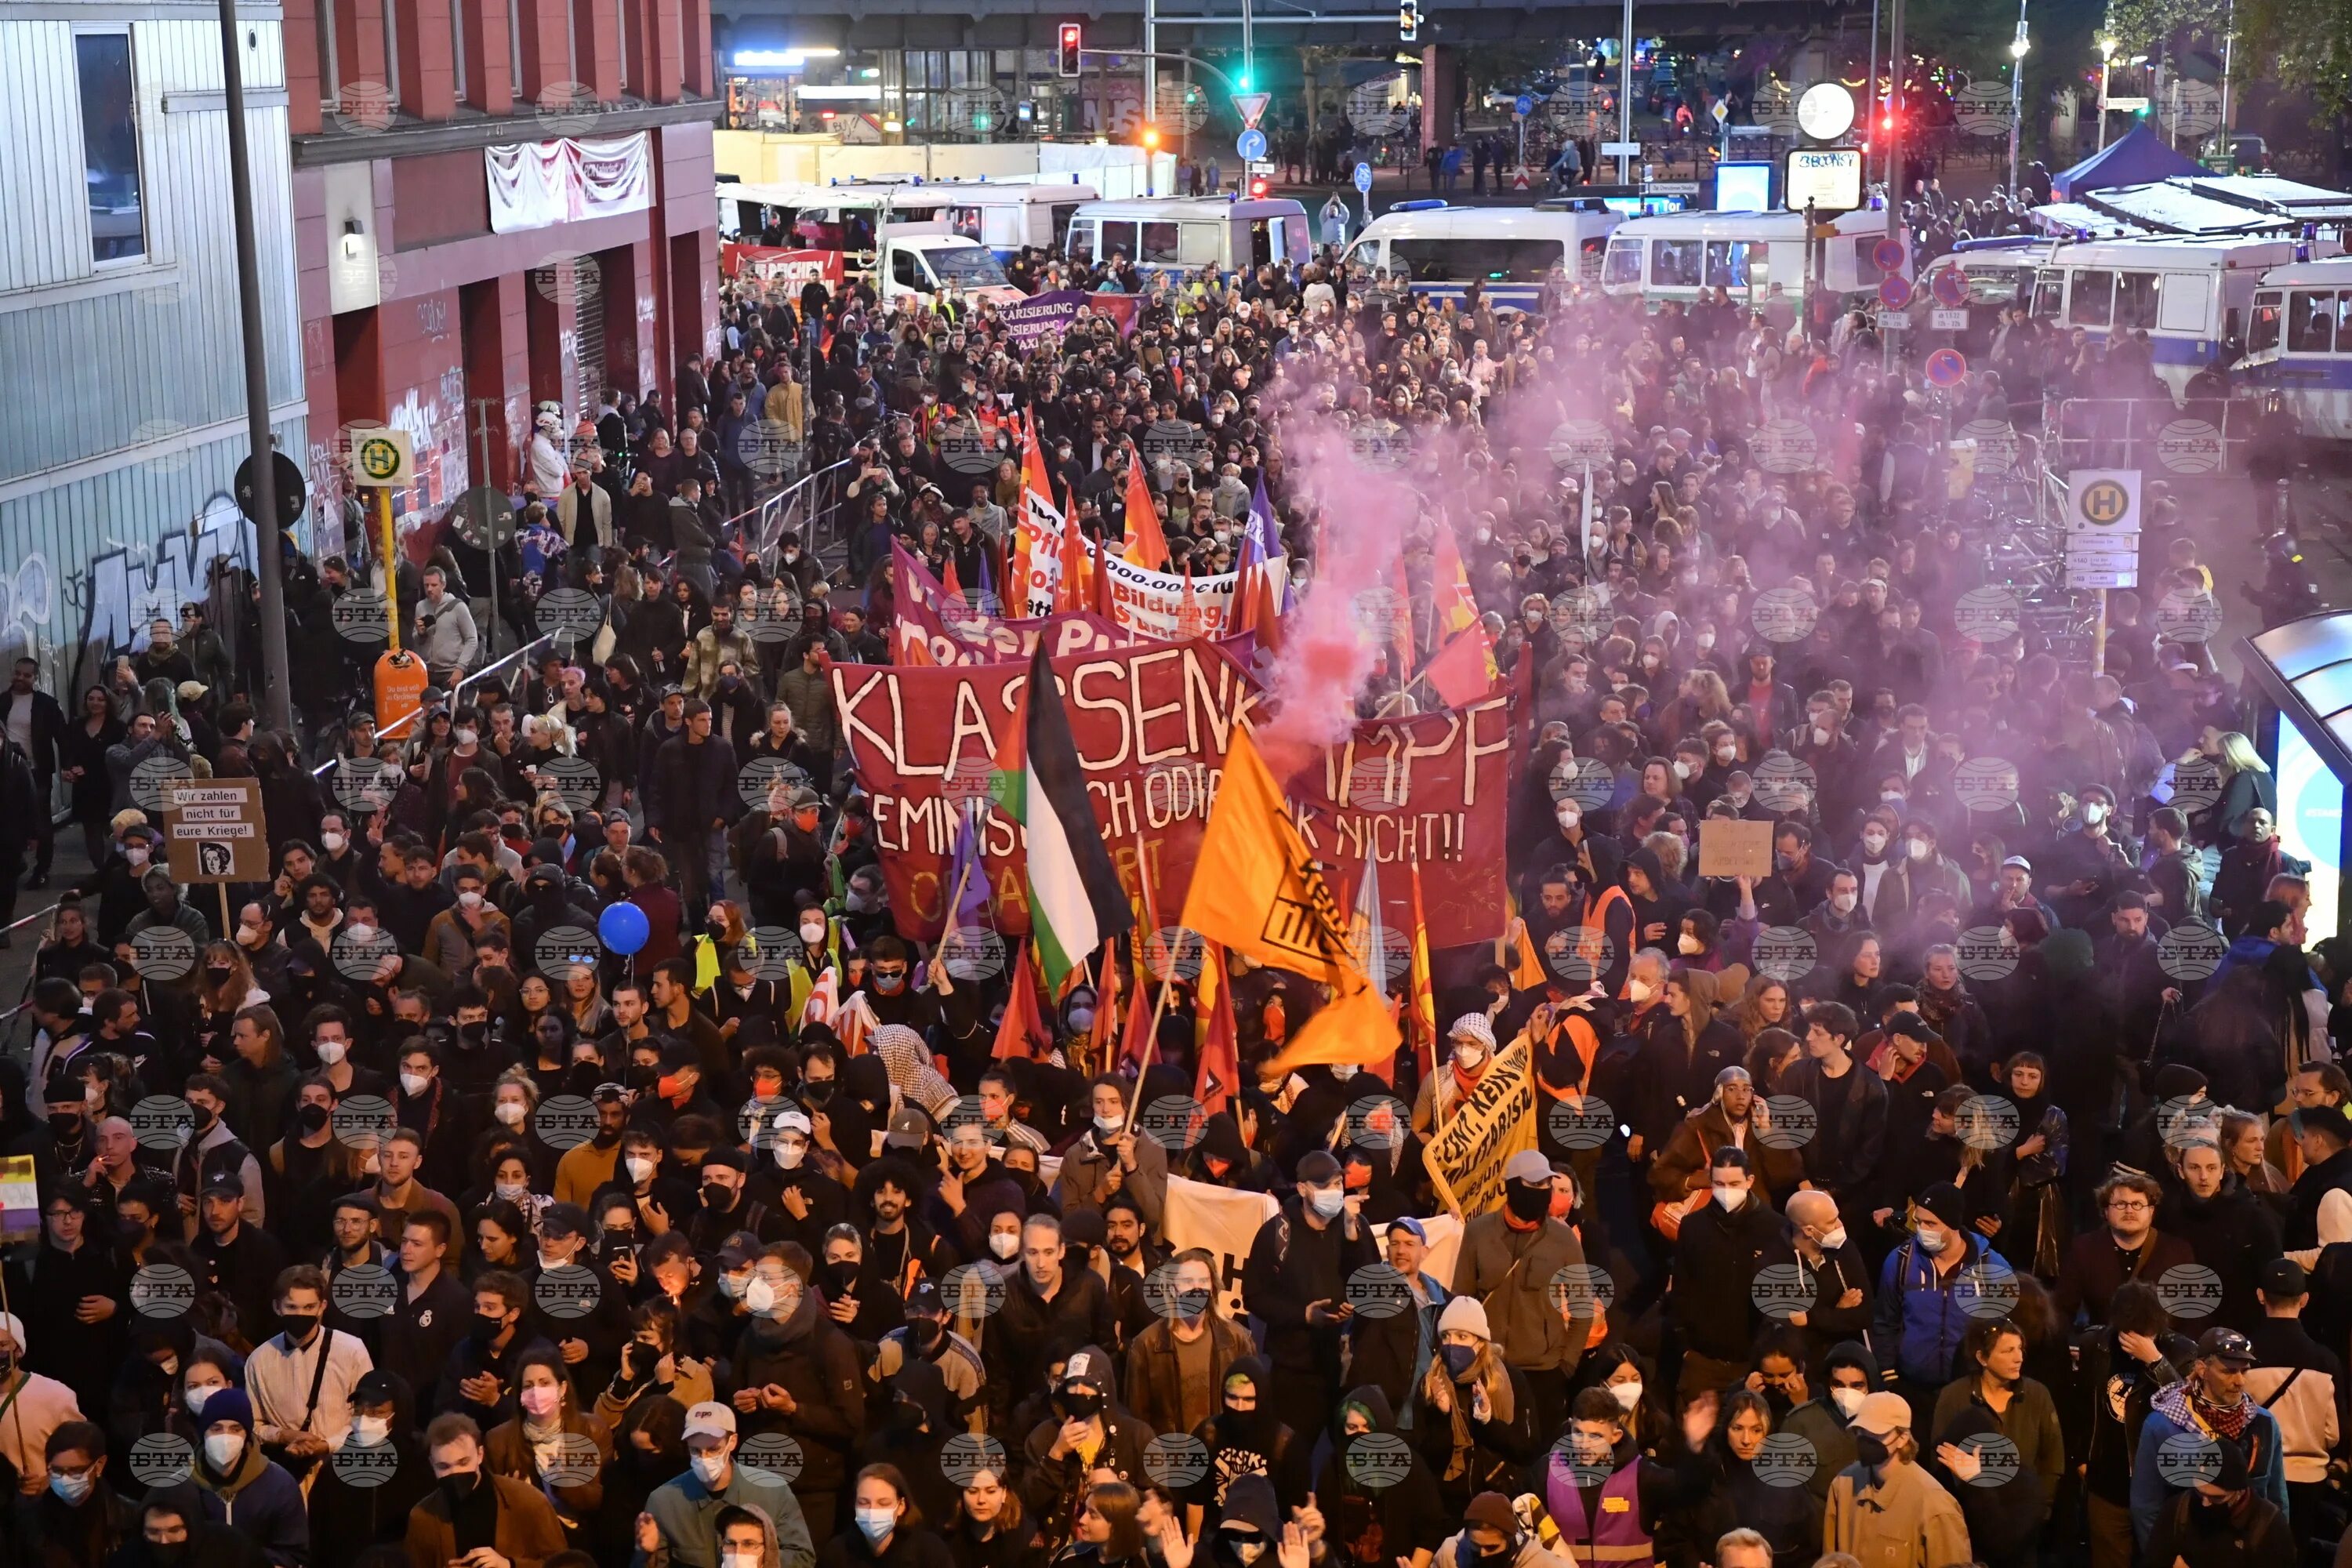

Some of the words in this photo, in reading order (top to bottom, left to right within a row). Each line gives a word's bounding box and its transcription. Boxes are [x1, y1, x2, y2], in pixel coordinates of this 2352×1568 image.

[1009, 319, 1061, 337] ISIERUNG
[371, 447, 389, 470] H
[2093, 490, 2116, 515] H
[177, 792, 195, 801] Wir
[201, 790, 237, 800] zahlen
[186, 808, 214, 818] nicht
[220, 808, 235, 818] für
[176, 827, 201, 837] eure
[208, 825, 247, 837] Kriege!
[1336, 812, 1465, 863] NICHT!!
[1468, 1066, 1521, 1118] KEIN
